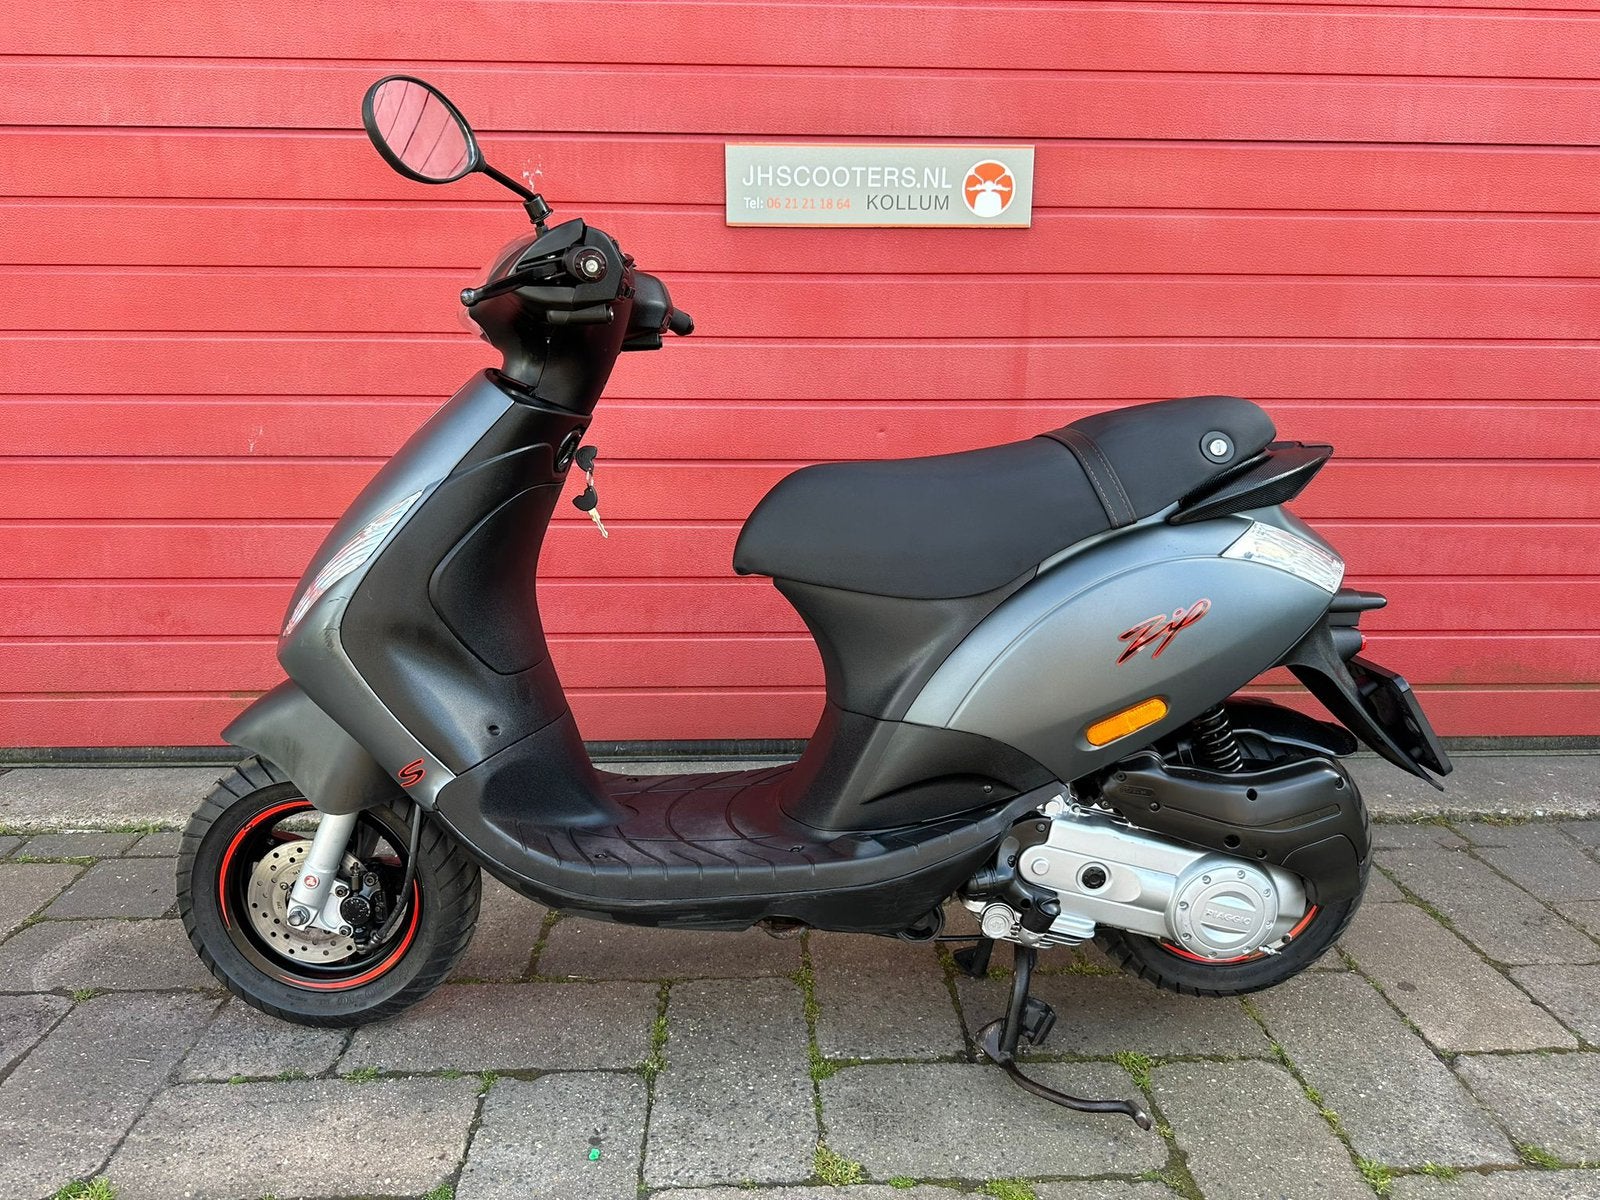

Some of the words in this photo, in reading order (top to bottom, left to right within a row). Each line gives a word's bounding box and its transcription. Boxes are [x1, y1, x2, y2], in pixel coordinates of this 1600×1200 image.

[742, 165, 952, 189] JHSCOOTERS.NL
[743, 196, 764, 209] Tel:
[766, 197, 781, 209] 06
[784, 198, 799, 210] 21
[802, 198, 816, 210] 21
[820, 198, 834, 210] 18
[836, 198, 852, 210] 64
[866, 194, 950, 211] KOLLUM
[1116, 598, 1212, 667] Zip
[398, 757, 426, 788] S
[1205, 908, 1252, 925] PIAGGIO
